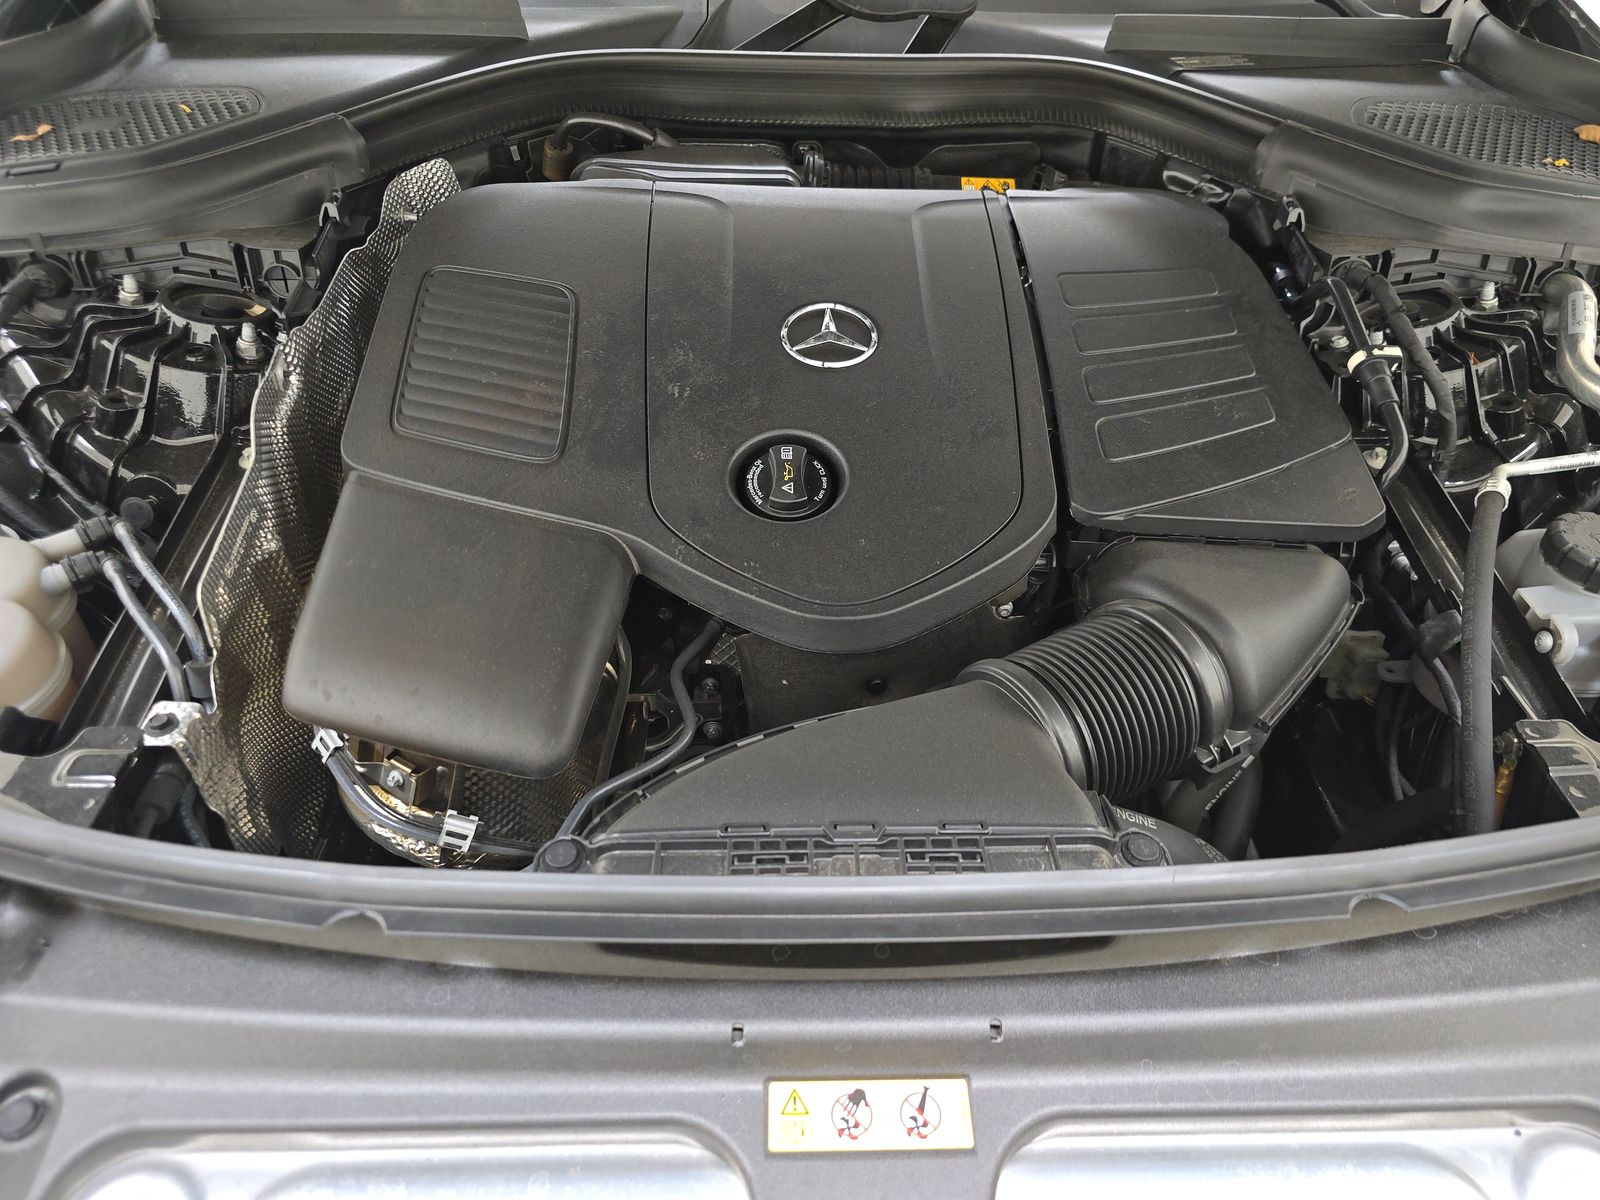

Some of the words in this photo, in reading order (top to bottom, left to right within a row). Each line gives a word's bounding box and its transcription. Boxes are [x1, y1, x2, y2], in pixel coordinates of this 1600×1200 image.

[746, 465, 763, 505] Mercedes-Benz
[753, 463, 764, 498] recommended
[813, 489, 826, 502] Turn
[820, 476, 828, 489] until
[1113, 808, 1157, 830] NGINE
